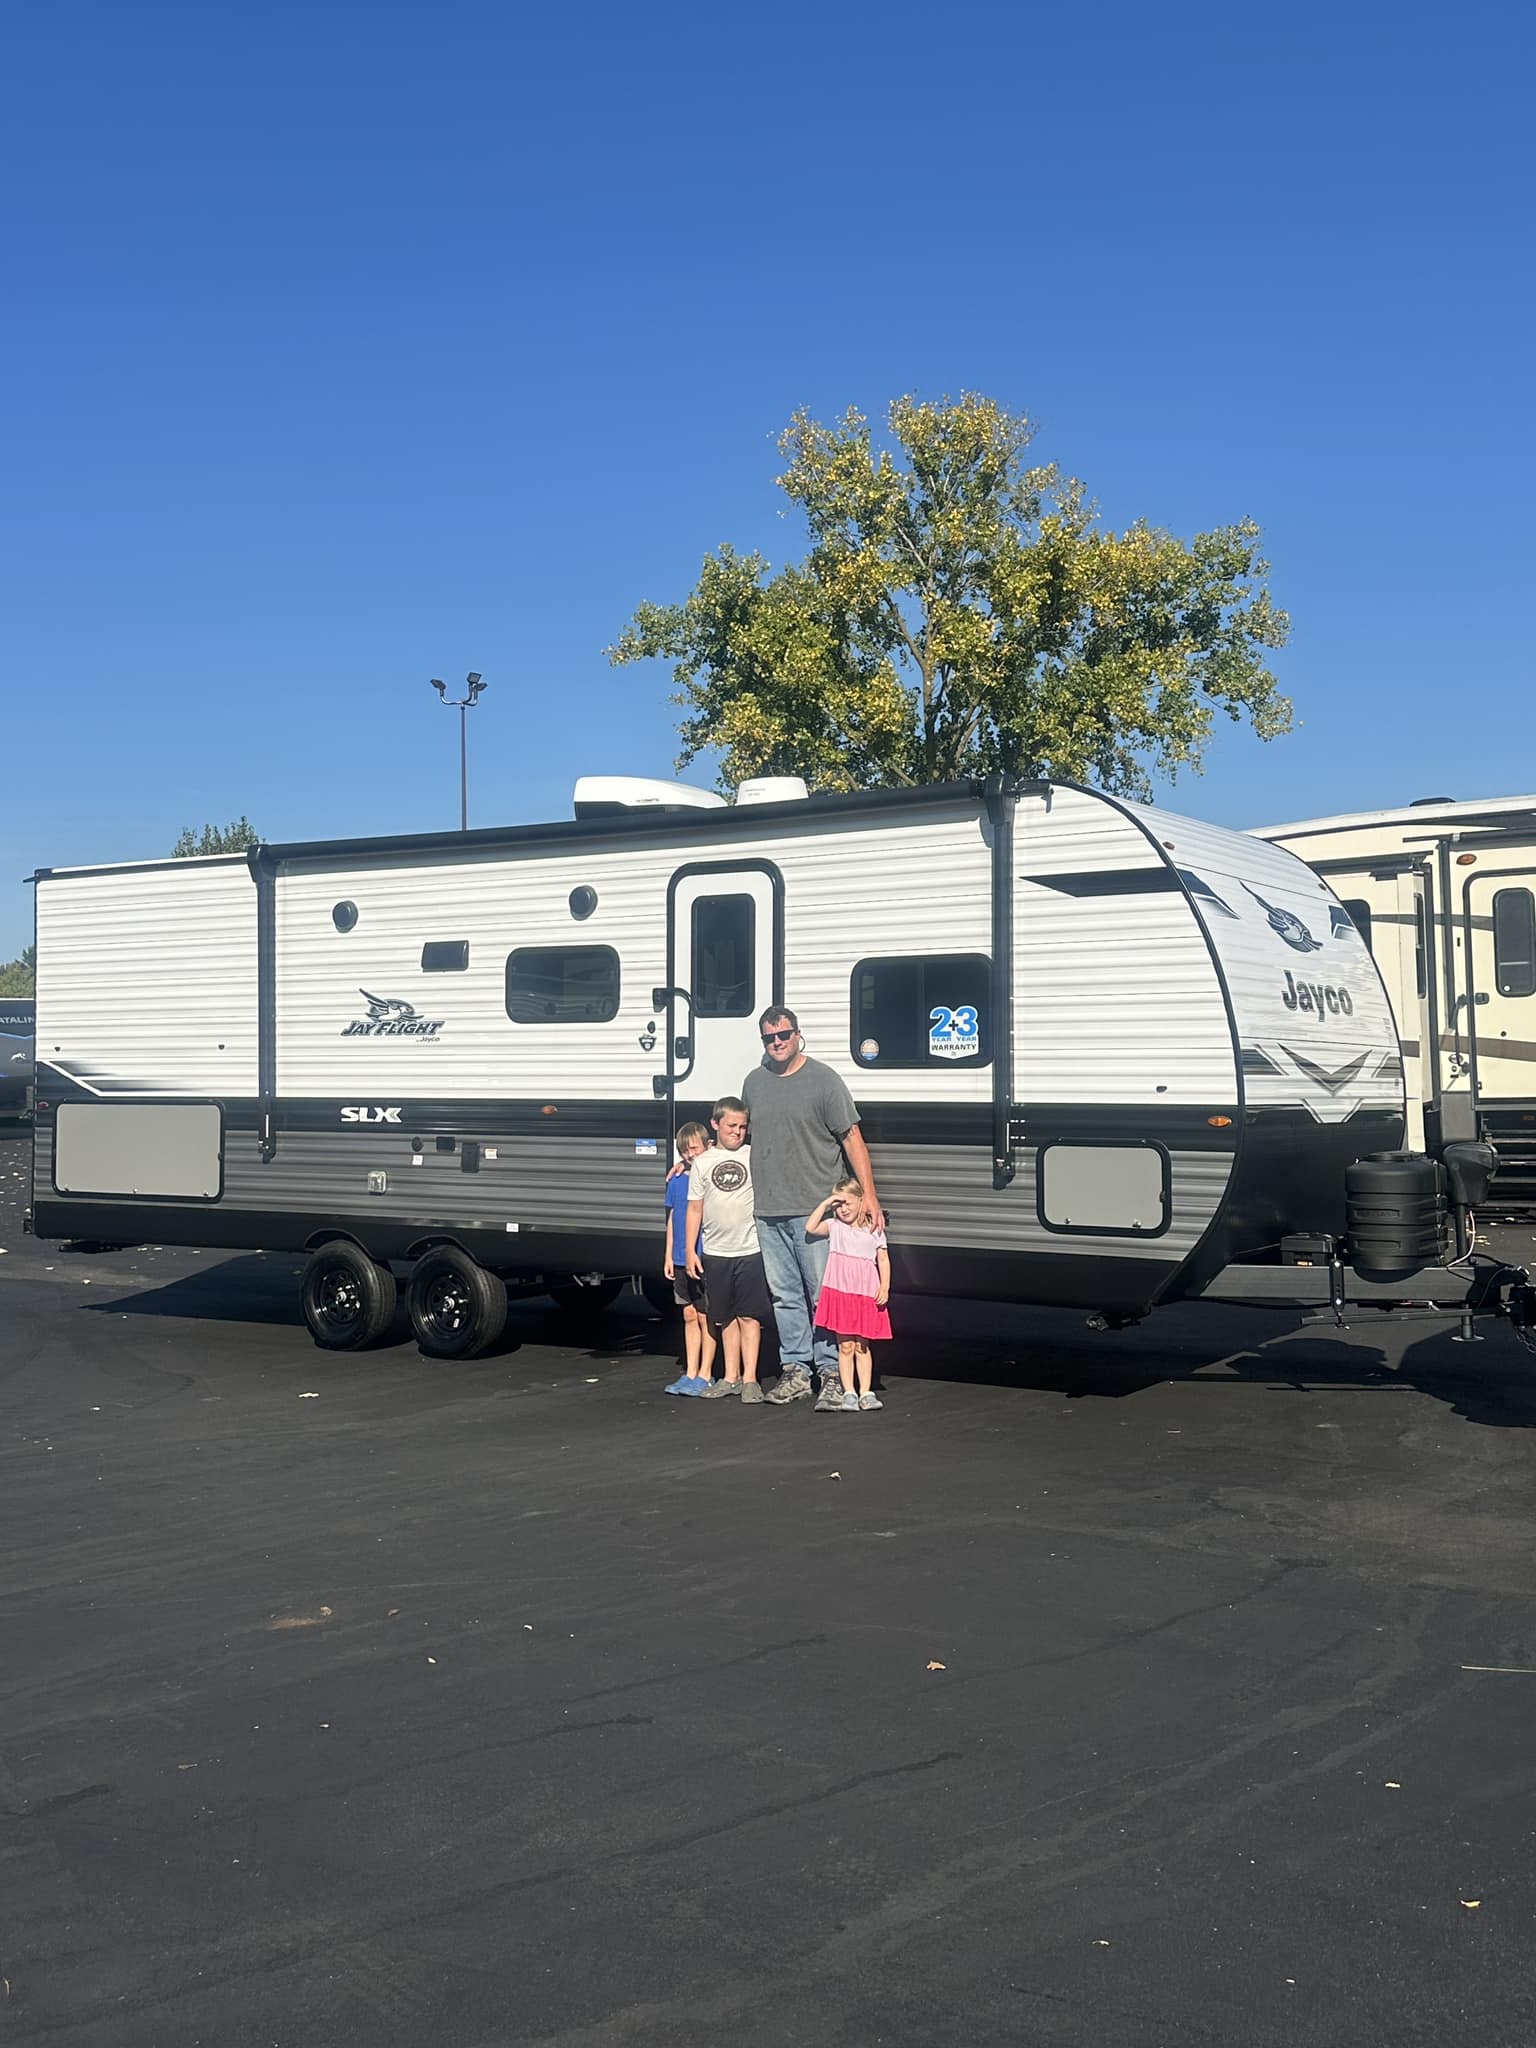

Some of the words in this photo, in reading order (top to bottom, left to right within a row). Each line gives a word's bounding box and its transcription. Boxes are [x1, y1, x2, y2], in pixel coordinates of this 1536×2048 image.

[1281, 969, 1353, 1022] Jayco
[340, 1020, 376, 1036] JAY
[374, 1020, 445, 1036] FLIGHT
[931, 1043, 977, 1051] WARRANTY
[340, 1106, 402, 1123] SLX
